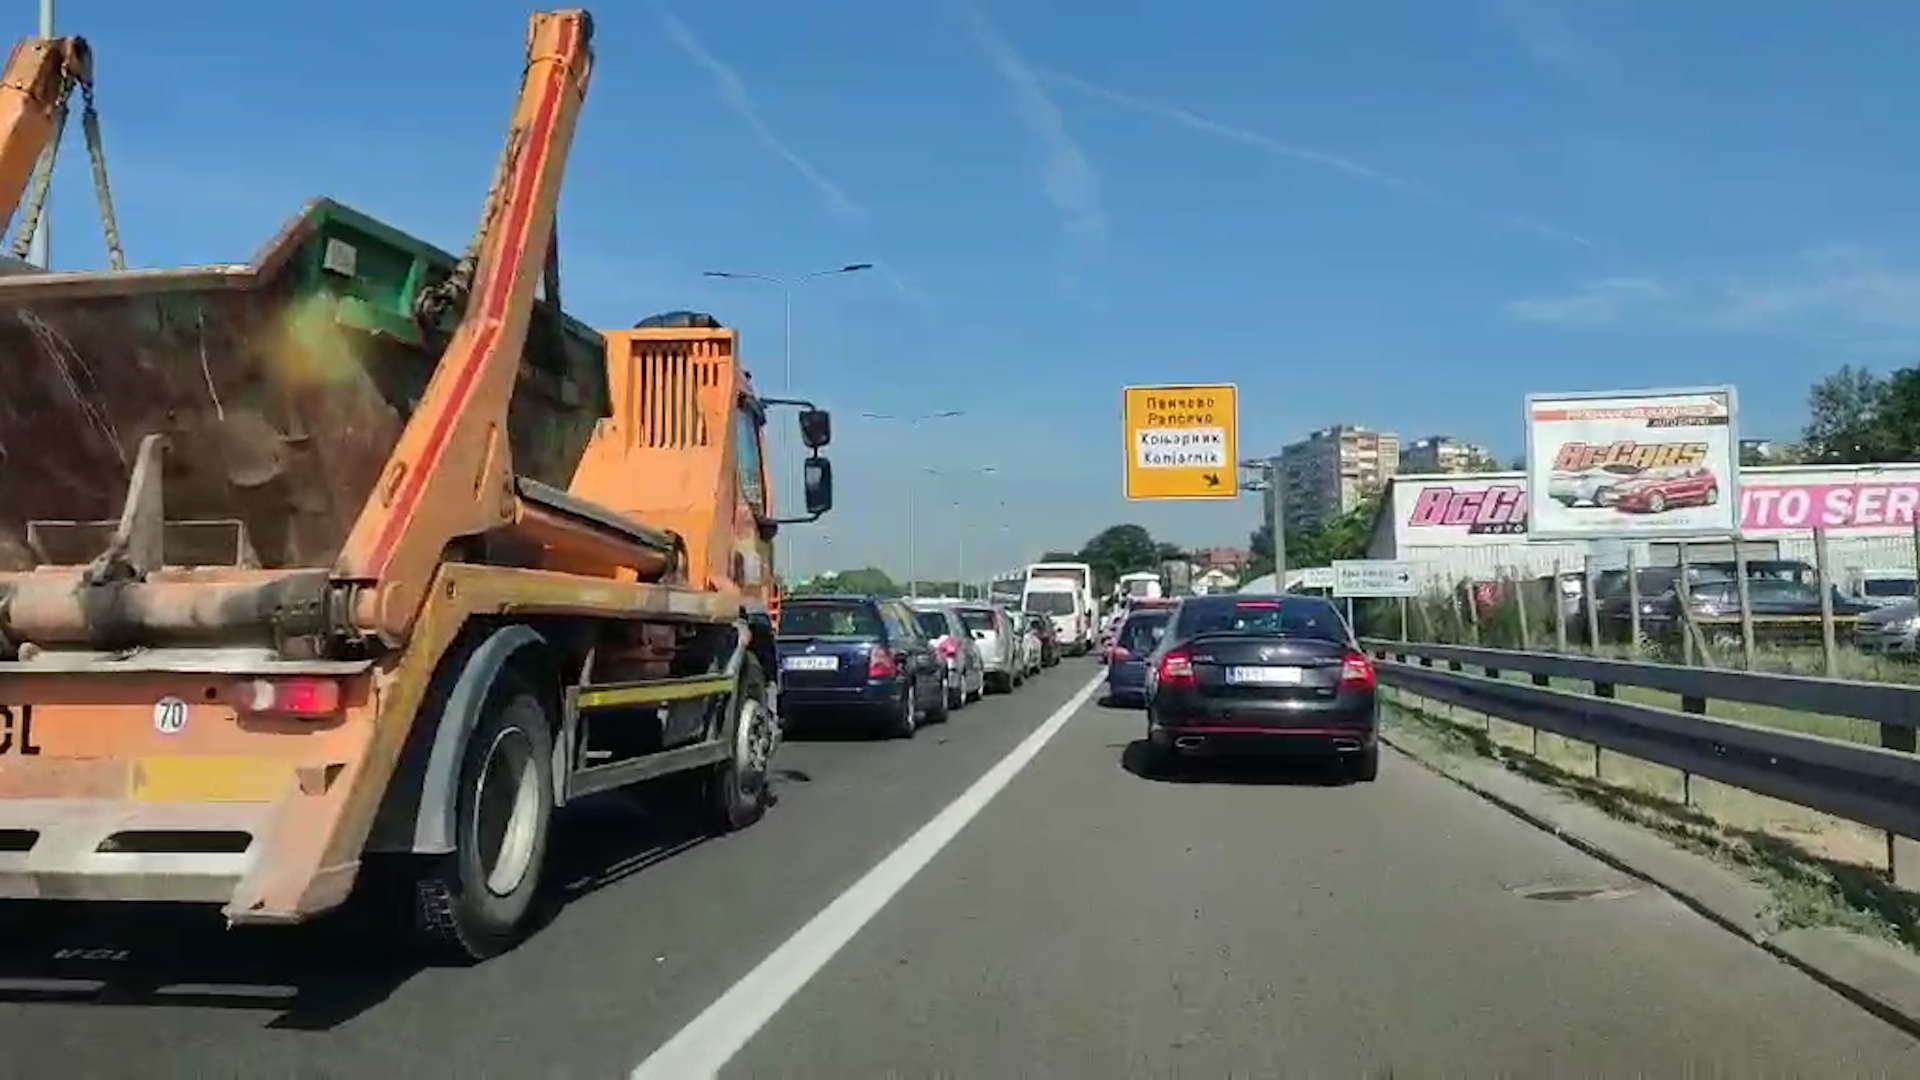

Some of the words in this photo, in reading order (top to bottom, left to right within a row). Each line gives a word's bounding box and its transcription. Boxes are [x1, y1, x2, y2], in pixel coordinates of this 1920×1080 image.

[1142, 434, 1220, 446] Коњарник
[1145, 453, 1218, 465] Konjarnik
[160, 702, 183, 728] 70
